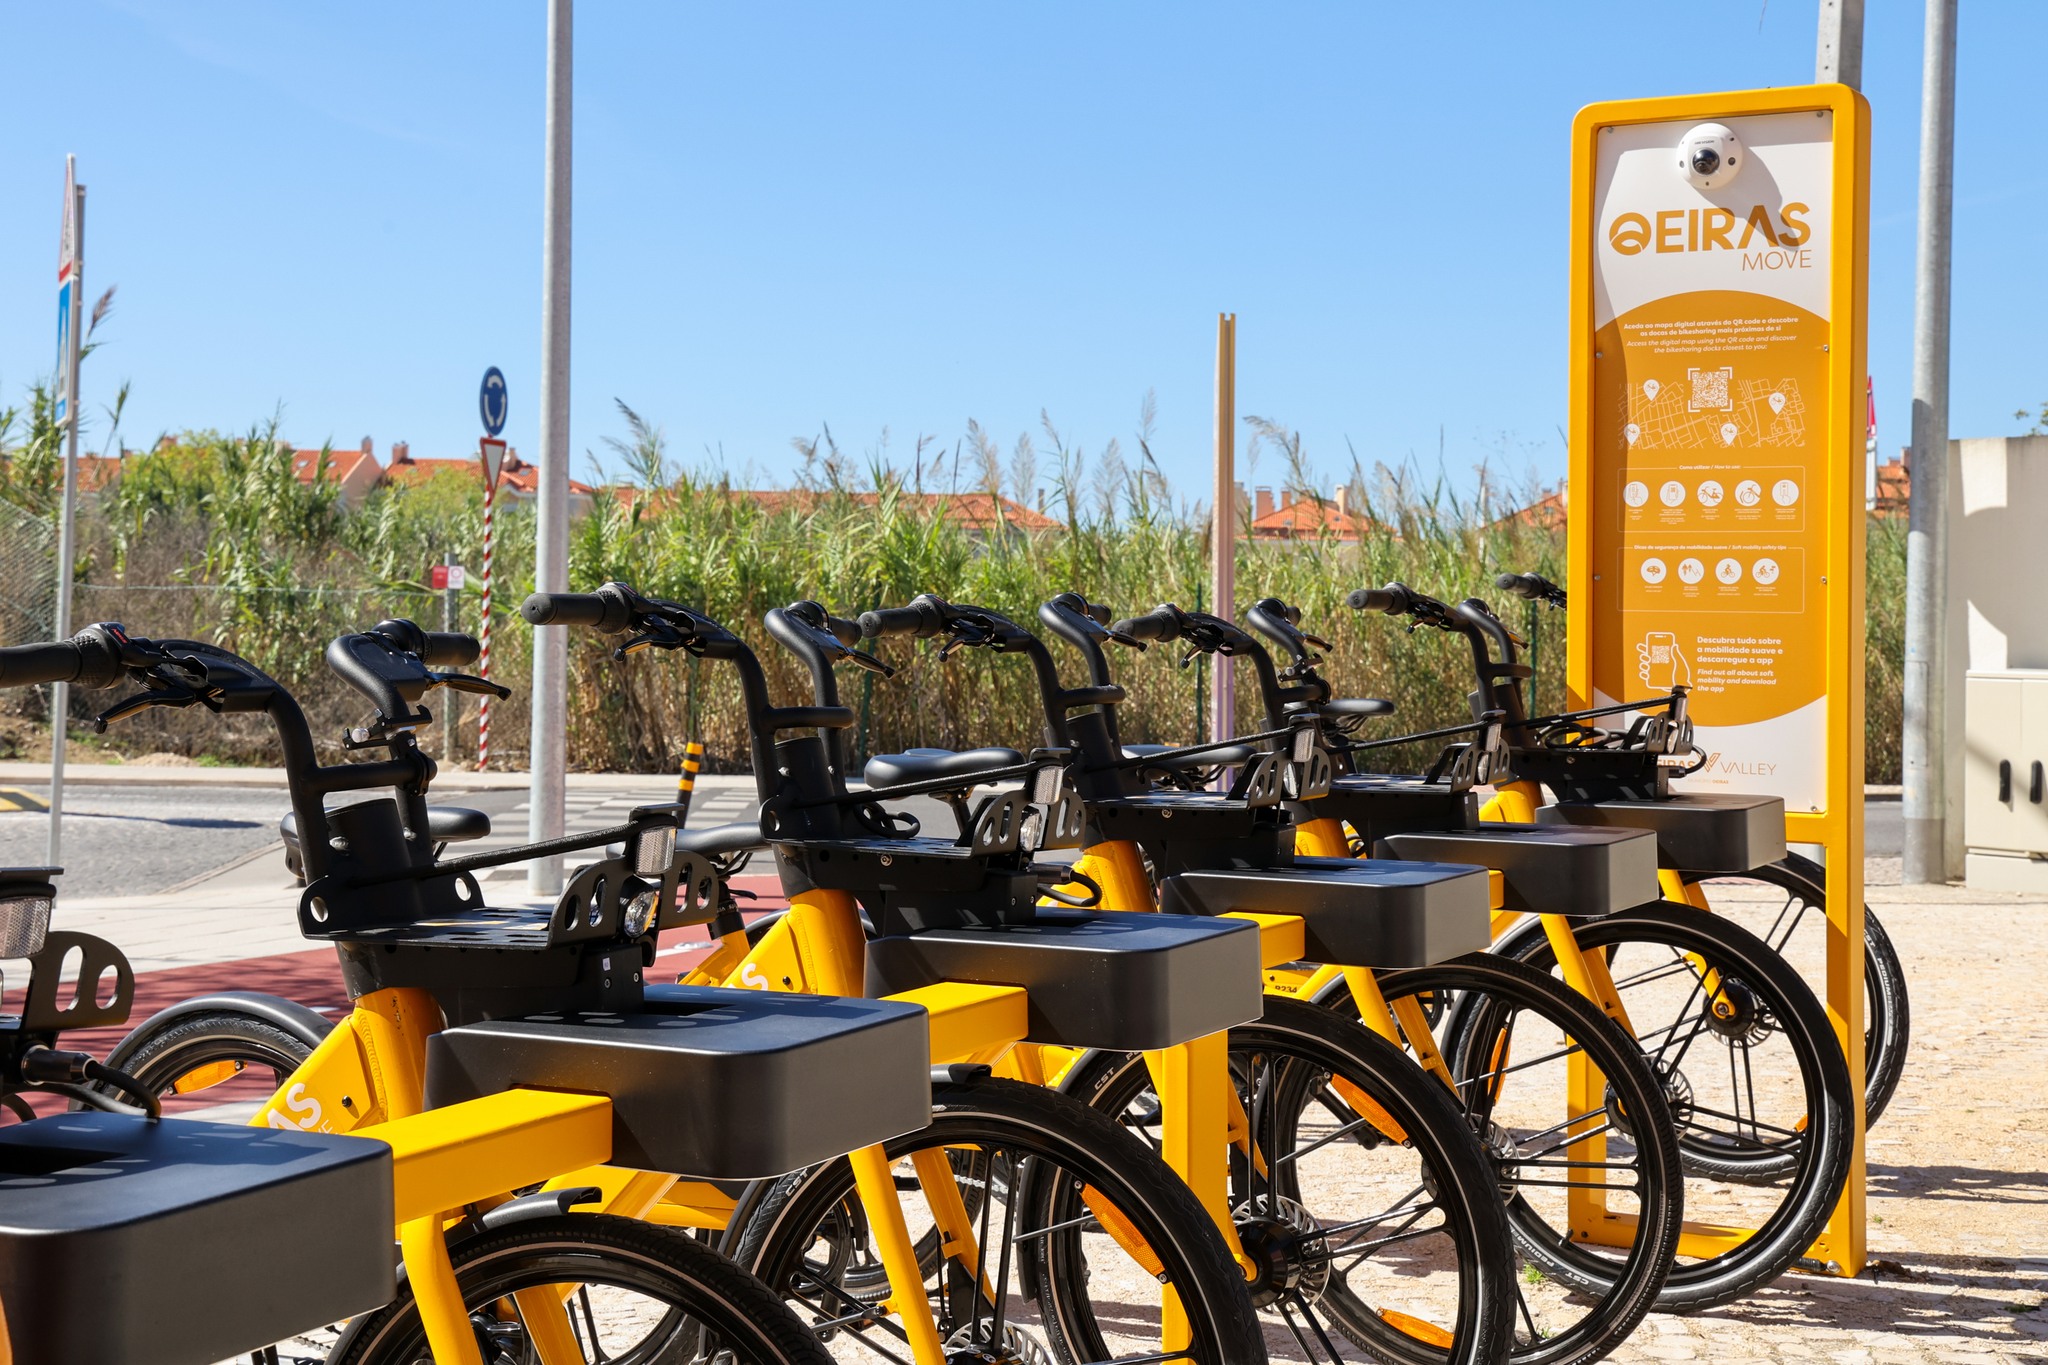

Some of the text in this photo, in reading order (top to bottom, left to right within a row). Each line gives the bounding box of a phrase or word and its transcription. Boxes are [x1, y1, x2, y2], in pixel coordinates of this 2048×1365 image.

[1609, 202, 1811, 256] OEIRAS
[1742, 250, 1812, 271] MOVE
[1697, 656, 1748, 665] descarregue
[1720, 762, 1776, 776] VALLEY
[1094, 1067, 1114, 1090] CST
[786, 1168, 808, 1196] CST
[1565, 1272, 1589, 1285] CST
